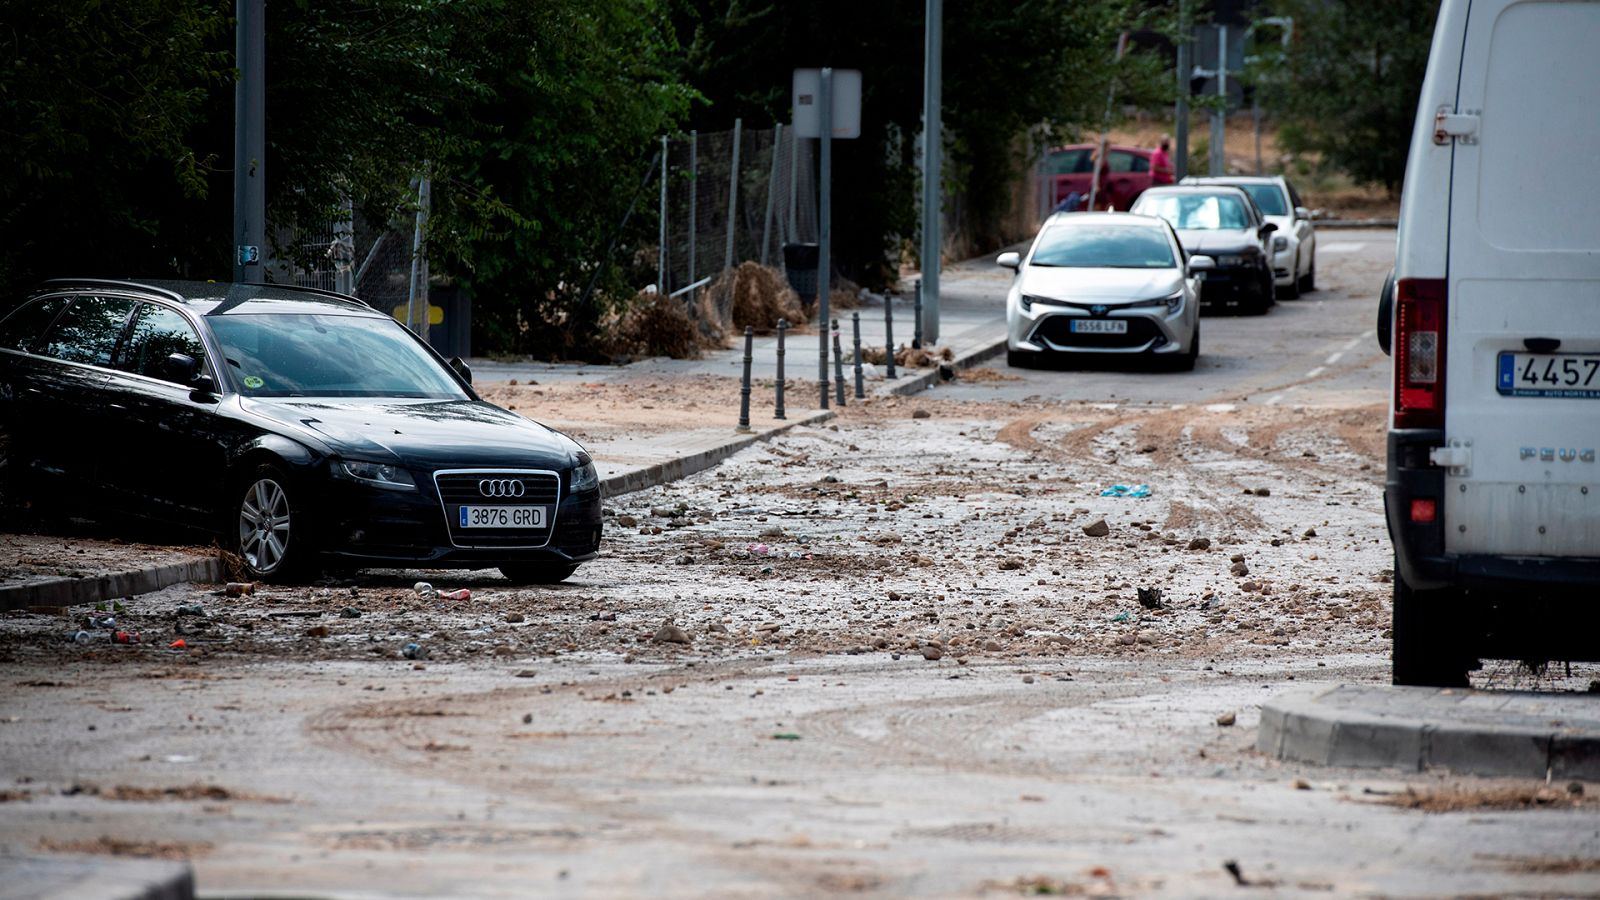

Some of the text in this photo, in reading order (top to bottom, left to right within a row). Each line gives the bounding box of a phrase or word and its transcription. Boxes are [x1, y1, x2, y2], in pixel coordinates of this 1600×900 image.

[1522, 358, 1600, 386] 4457
[1520, 447, 1595, 463] PEUG
[472, 509, 541, 525] 3876 GRD
